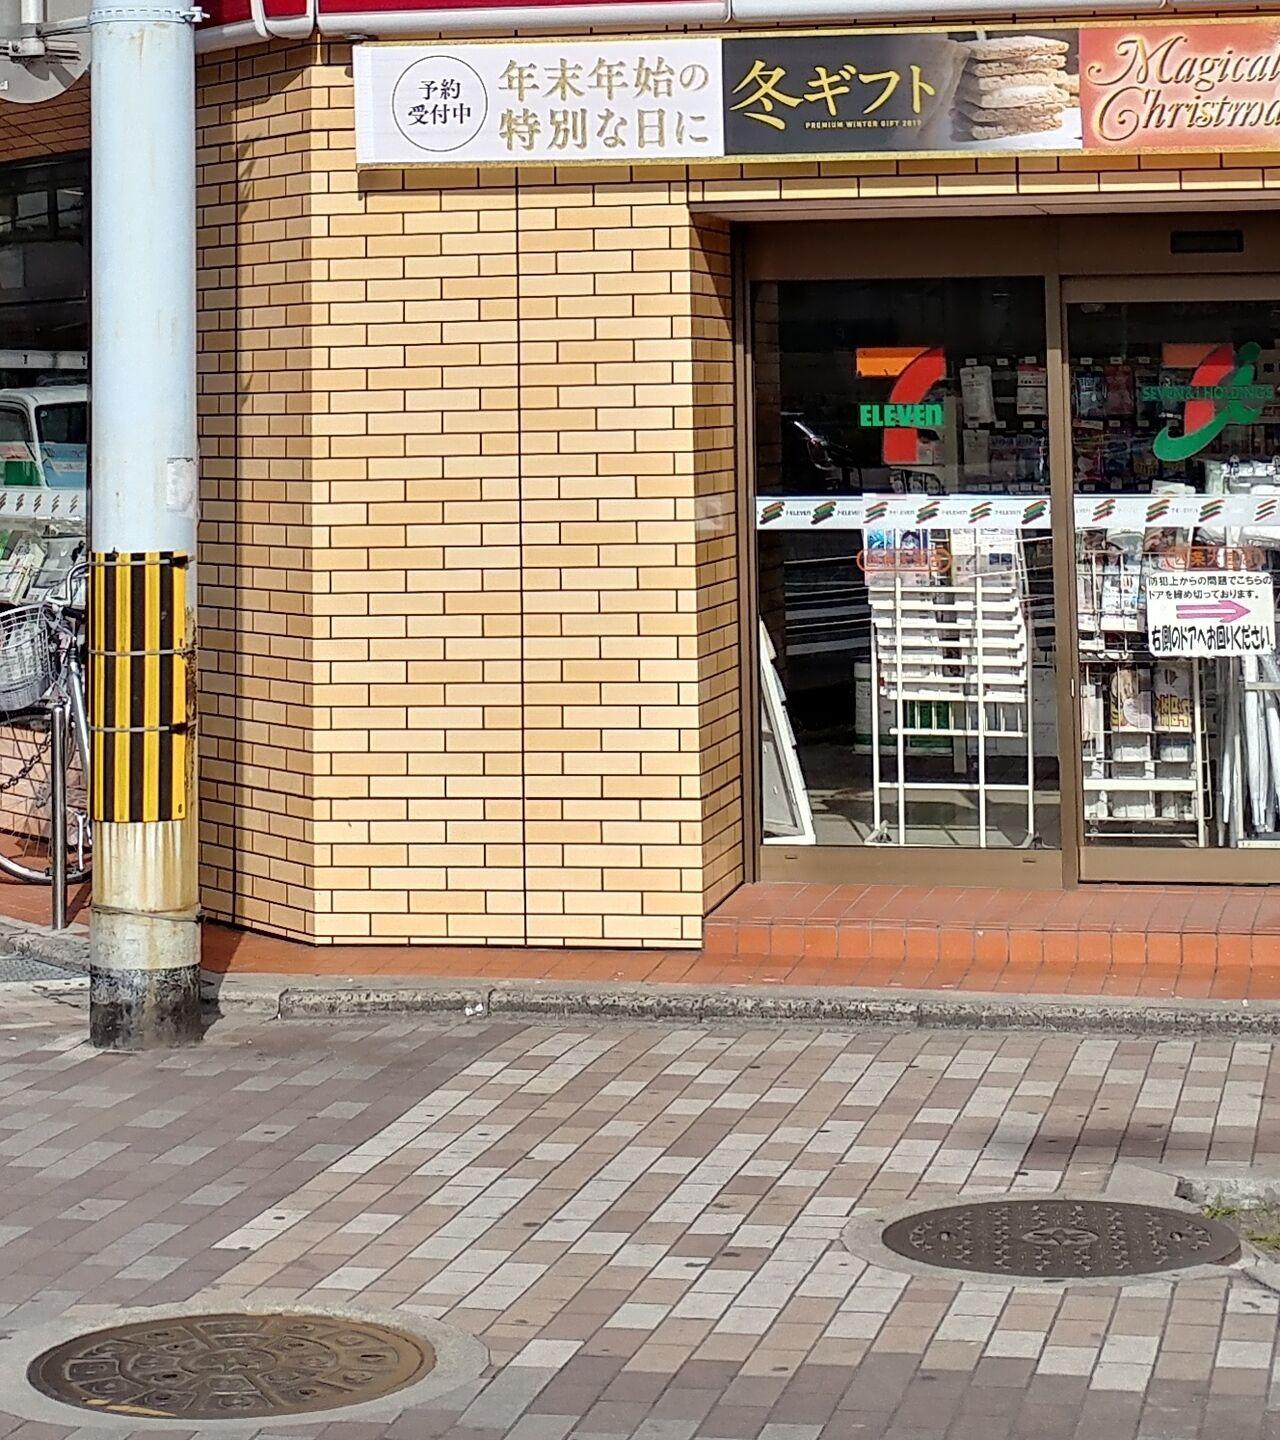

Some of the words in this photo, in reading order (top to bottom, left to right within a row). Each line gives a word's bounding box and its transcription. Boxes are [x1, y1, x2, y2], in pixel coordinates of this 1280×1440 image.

[418, 79, 461, 101] 予約
[498, 56, 709, 105] 年末年始の
[729, 59, 936, 131] 冬ギフト
[408, 104, 471, 127] 受付中
[498, 107, 709, 152] 特別な日に
